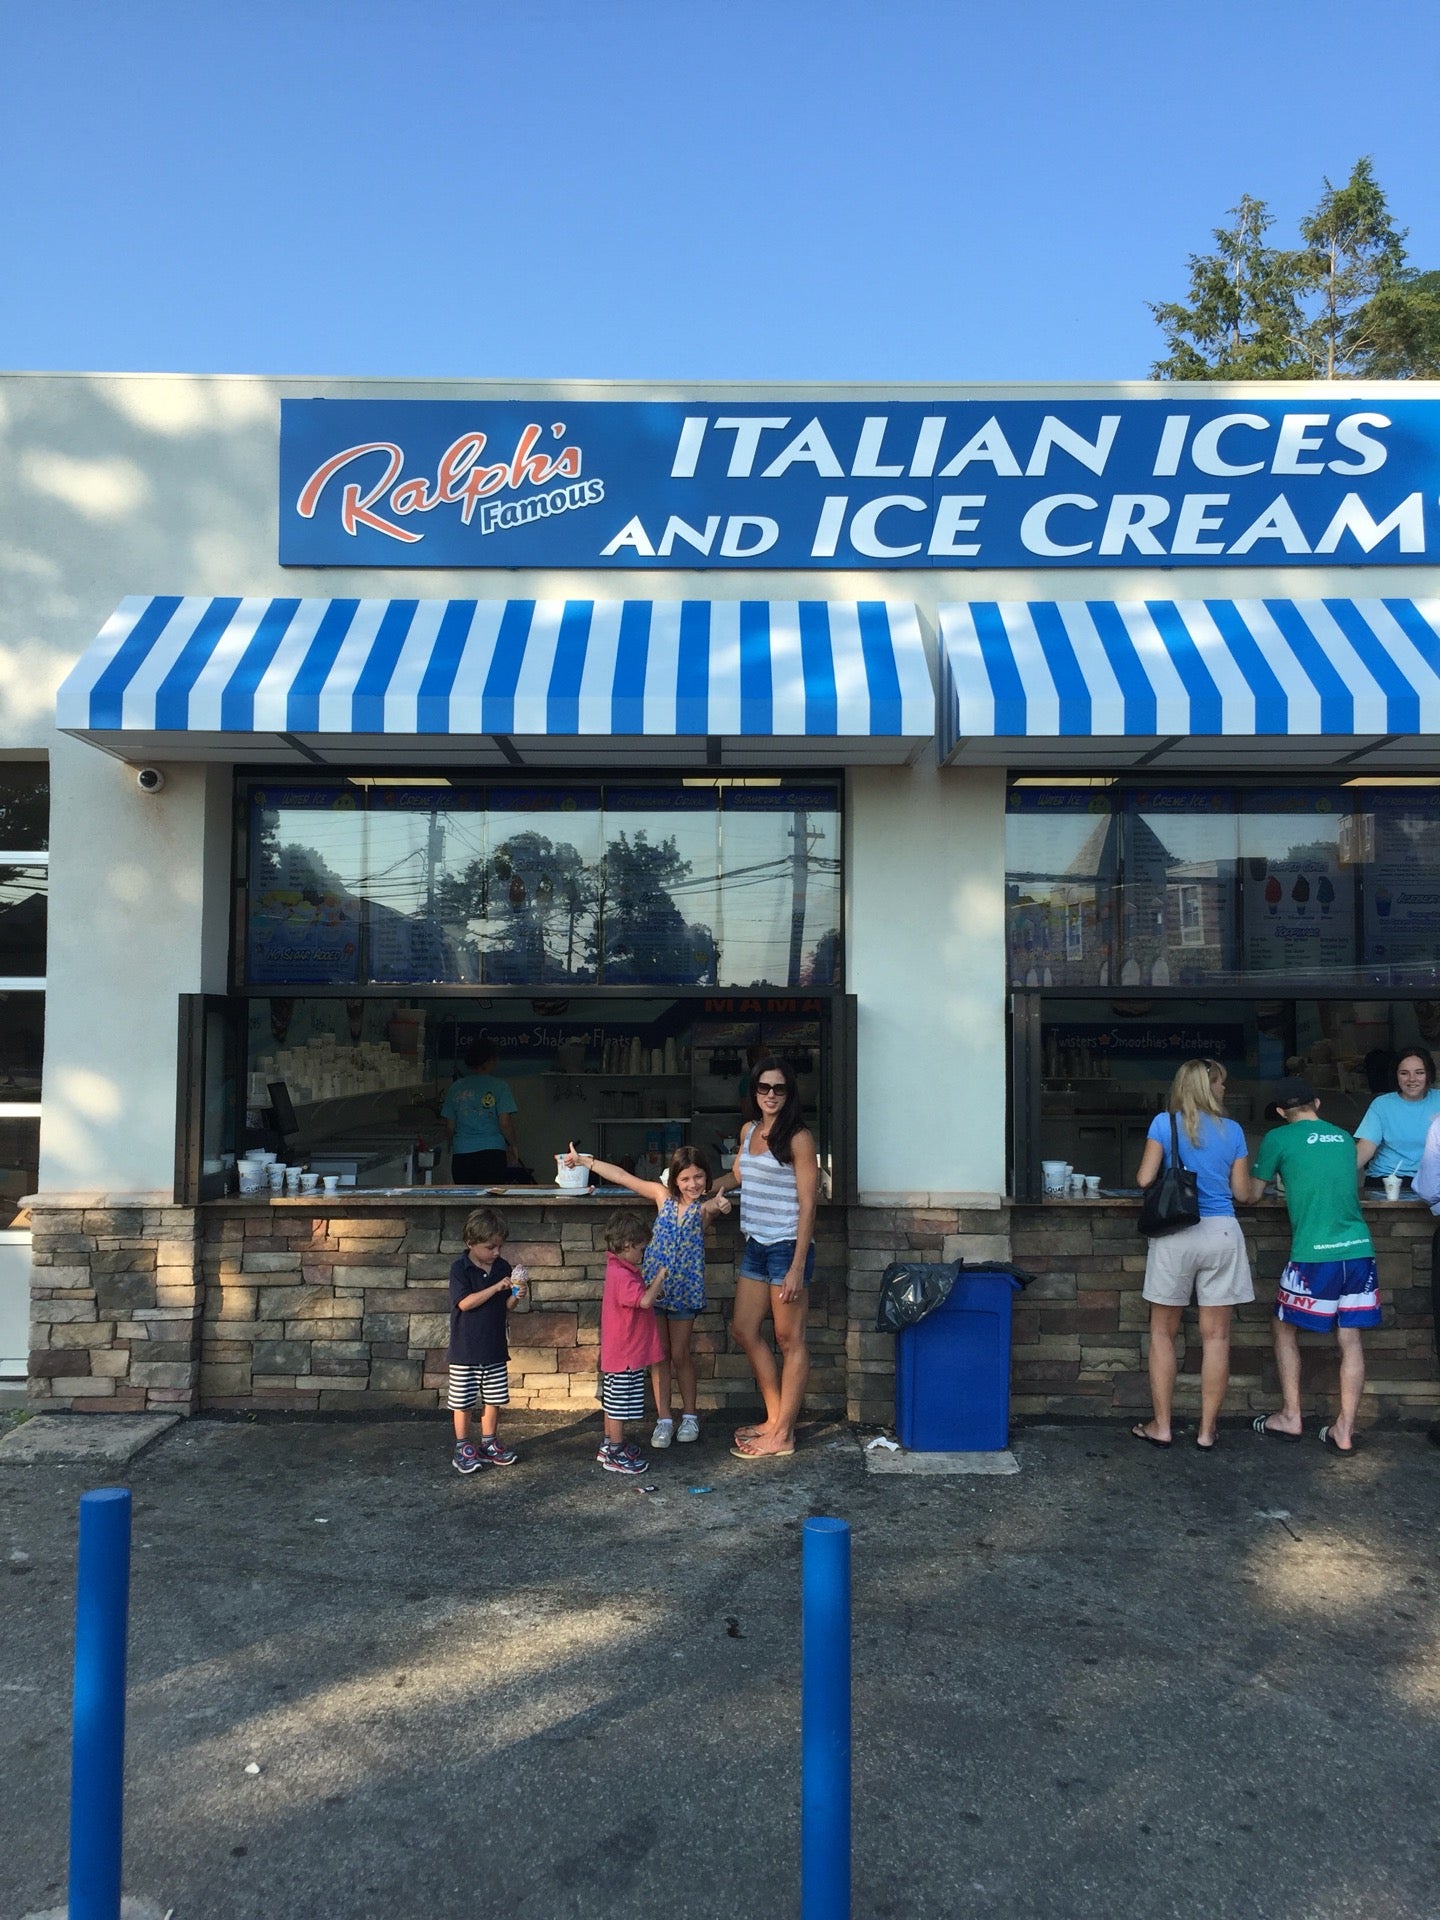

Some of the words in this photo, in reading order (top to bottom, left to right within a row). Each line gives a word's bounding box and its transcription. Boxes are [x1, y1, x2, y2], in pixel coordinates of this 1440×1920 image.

[671, 415, 1121, 478] ITALIAN
[1152, 412, 1392, 477] ICES
[296, 422, 582, 544] Ralph's
[481, 479, 604, 535] Famous
[600, 515, 779, 558] AND
[810, 495, 987, 558] ICE
[1020, 492, 1425, 558] CREAM
[1050, 1028, 1097, 1048] Twisters
[1110, 1028, 1168, 1049] Smoothies
[1180, 1030, 1227, 1054] Icebergs
[1319, 1134, 1345, 1143] asics
[1294, 1296, 1317, 1310] NY
